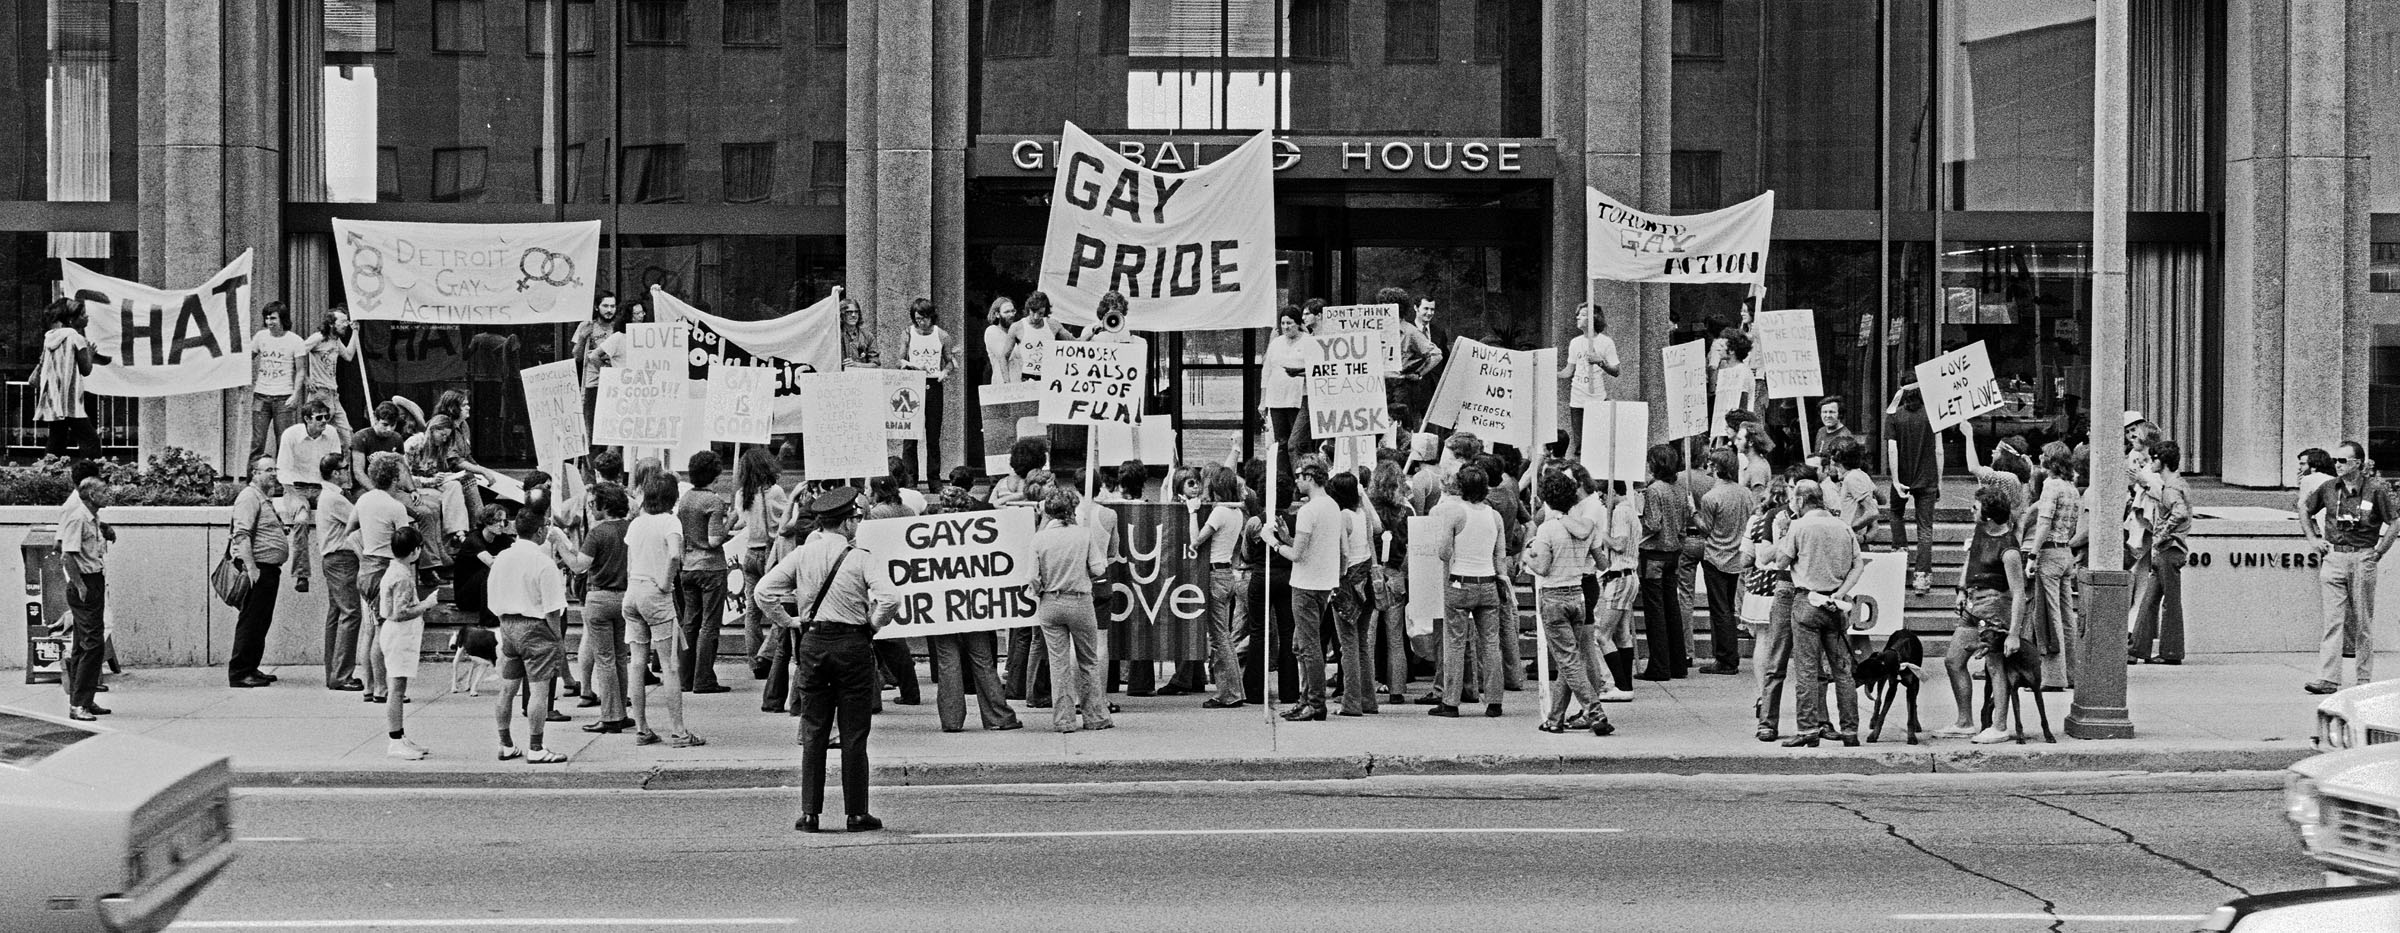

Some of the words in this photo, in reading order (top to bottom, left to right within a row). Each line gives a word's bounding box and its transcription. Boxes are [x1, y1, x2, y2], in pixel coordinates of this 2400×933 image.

[1012, 140, 1208, 170] GLBAL
[1341, 142, 1521, 171] HOUSE
[1065, 152, 1187, 224] GAY
[1597, 203, 1687, 235] TORONTO
[397, 239, 509, 266] DETROIT
[1620, 229, 1697, 258] GAY
[1067, 233, 1241, 299] PRIDE
[1663, 252, 1760, 275] ACTION
[435, 269, 481, 297] GAY
[400, 297, 513, 322] ACTIVISTS
[1357, 307, 1391, 317] THINK
[1338, 319, 1383, 330] TWICE
[1760, 313, 1786, 327] OUT
[632, 327, 683, 349] LOVE
[1024, 340, 1044, 350] GA
[262, 351, 285, 359] GAY
[912, 348, 940, 357] GAY
[1055, 345, 1118, 361] HOMOSEX
[1316, 335, 1368, 362] YOU
[1472, 345, 1513, 365] HUMA
[1763, 350, 1788, 365] INTO
[1791, 349, 1812, 363] THE
[645, 359, 671, 372] AND
[1064, 363, 1079, 377] IS
[1087, 364, 1138, 381] ALSO
[1312, 364, 1339, 377] ARE
[1345, 363, 1369, 376] THE
[1941, 354, 1971, 377] LOVE
[620, 368, 657, 386] GAY
[1313, 375, 1385, 397] REASON
[1768, 368, 1820, 389] STREETS
[1952, 377, 1969, 391] AND
[606, 386, 618, 399] IS
[1050, 379, 1063, 393] A
[1071, 380, 1102, 394] LOT
[1107, 382, 1132, 399] OF
[1485, 384, 1513, 399] NOT
[615, 397, 656, 416] GAY
[735, 394, 750, 413] IS
[1461, 400, 1513, 418] HETEROSEX
[1938, 395, 1963, 421] LET
[1969, 378, 2002, 411] LOVE
[618, 416, 681, 439] GREAT
[1316, 407, 1386, 435] MASK
[1472, 415, 1505, 430] RIGHTS
[905, 517, 999, 550] GAYS
[1183, 543, 1199, 560] IS
[2188, 552, 2212, 567] 80
[2229, 552, 2320, 568] UNIVERS
[888, 551, 1014, 587] DEMAND
[893, 592, 935, 626] UR
[945, 584, 1037, 622] RIGHTS
[1110, 575, 1206, 626] ove
